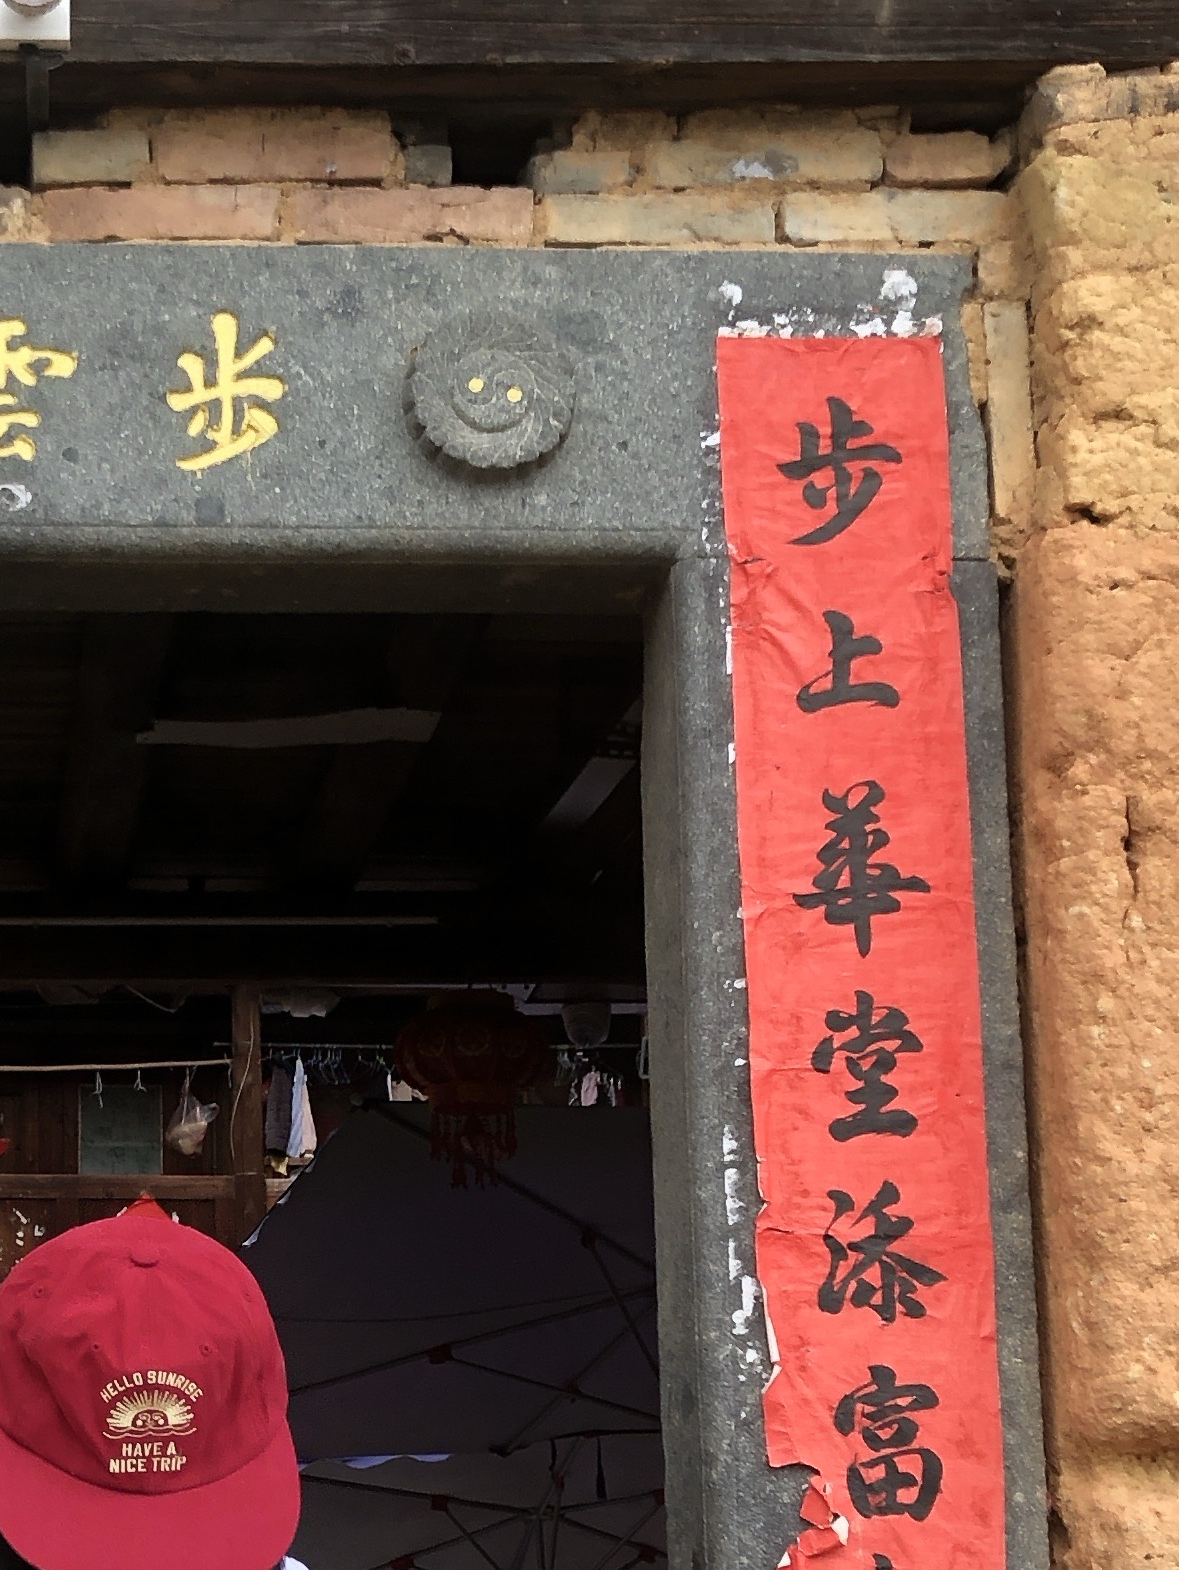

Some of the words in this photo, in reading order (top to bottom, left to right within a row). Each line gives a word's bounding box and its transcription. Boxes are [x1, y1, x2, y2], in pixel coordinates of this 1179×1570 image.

[100, 1372, 143, 1403] HELLO
[147, 1370, 203, 1402] SUNRISE
[122, 1442, 163, 1457] HAVE
[166, 1441, 177, 1456] A
[109, 1458, 147, 1473] NICE
[152, 1456, 187, 1472] TRIP
